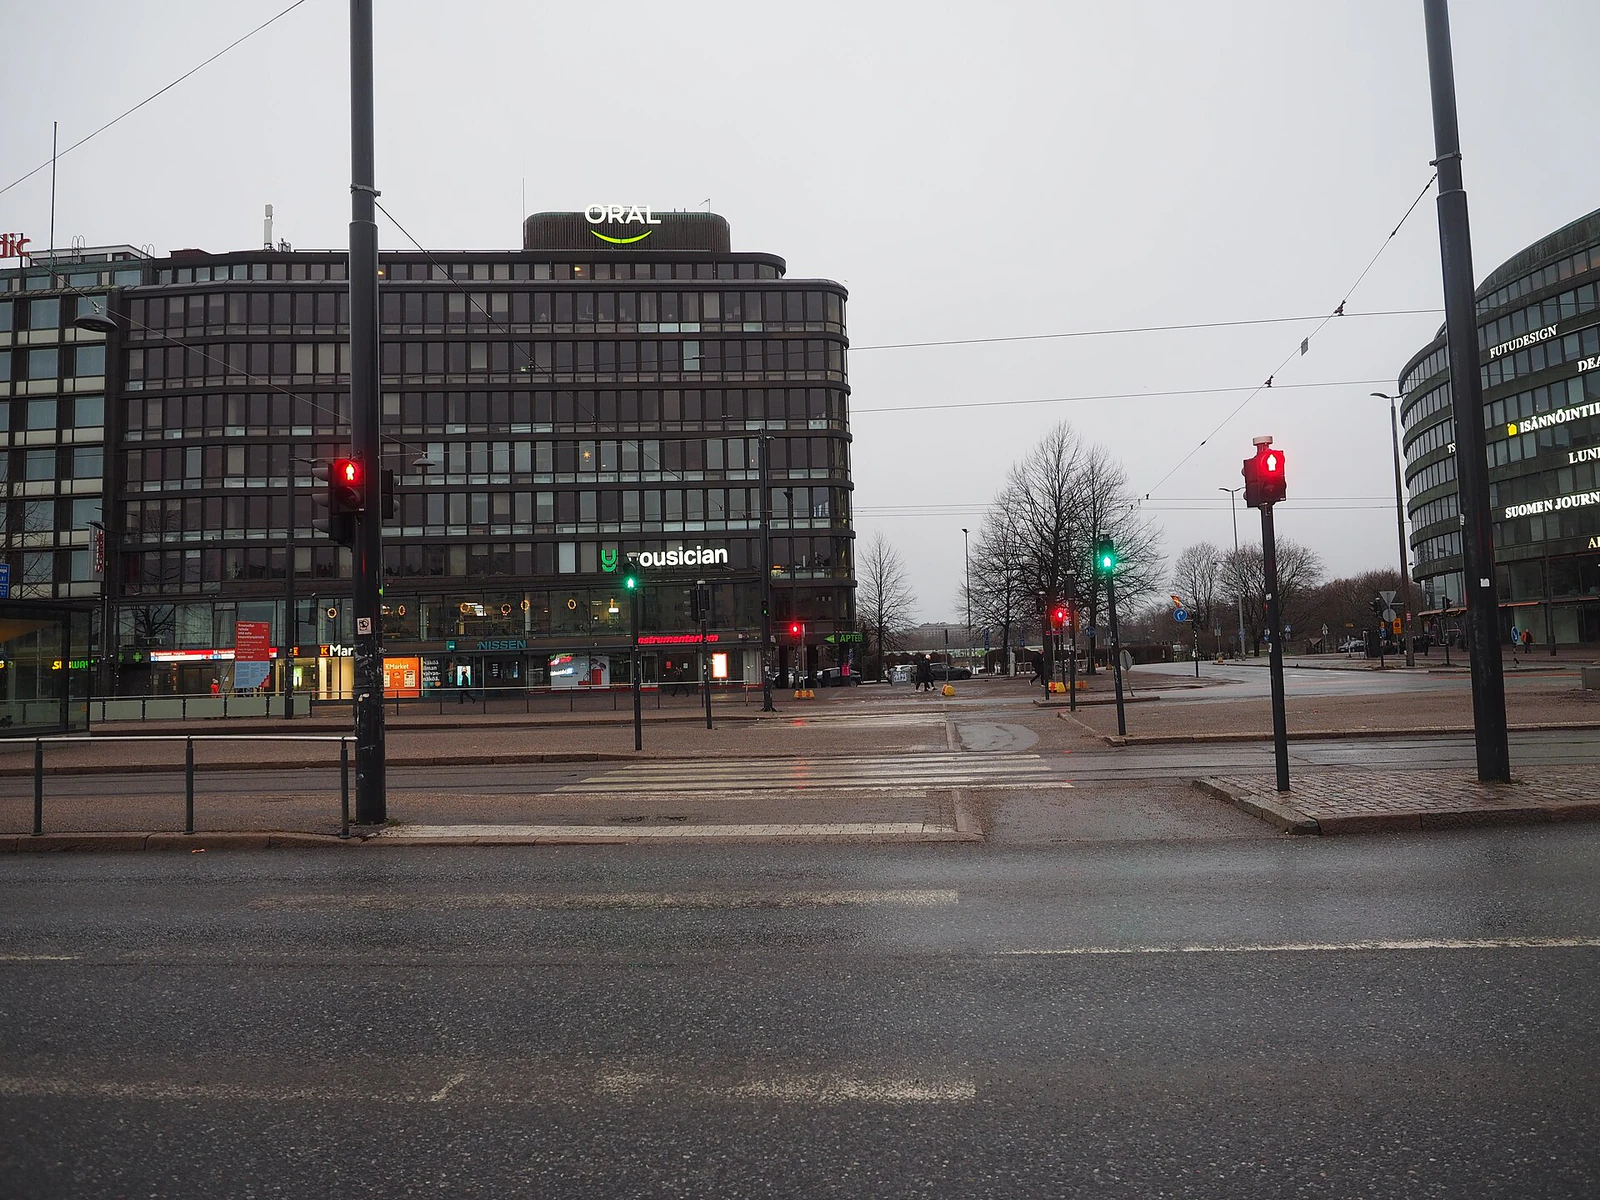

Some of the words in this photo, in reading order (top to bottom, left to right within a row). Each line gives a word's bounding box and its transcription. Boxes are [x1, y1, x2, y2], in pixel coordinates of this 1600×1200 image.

[584, 204, 661, 224] ORAL
[1489, 324, 1558, 359] FUTUDESIGN
[1568, 447, 1600, 464] LUN
[1505, 500, 1553, 519] SUOMEN
[1555, 491, 1600, 510] JOURN
[629, 545, 728, 568] ousician
[478, 640, 527, 650] NISSEN
